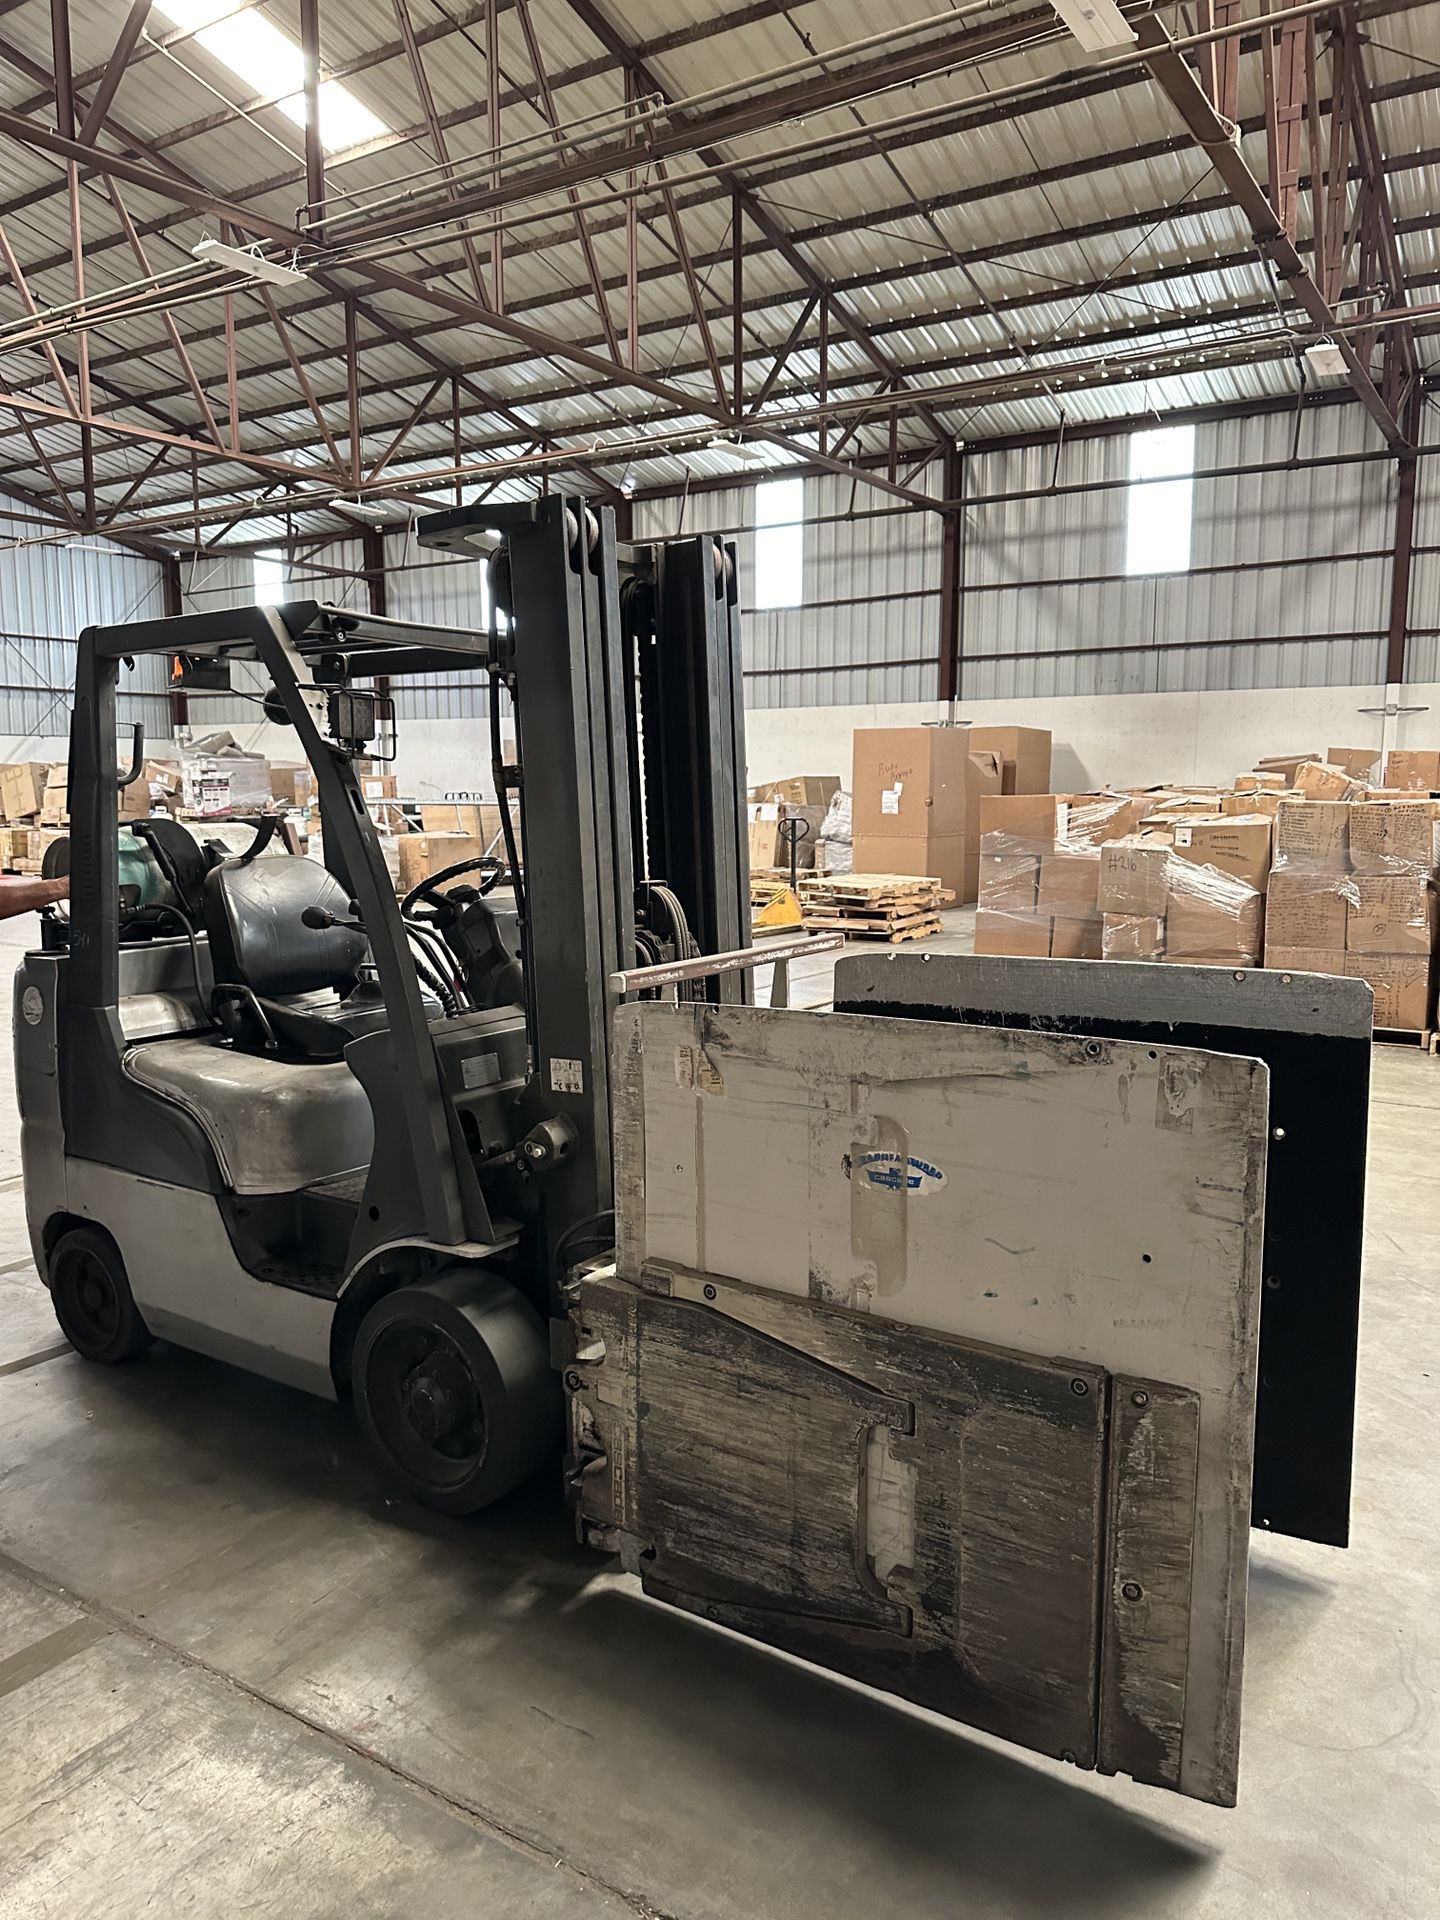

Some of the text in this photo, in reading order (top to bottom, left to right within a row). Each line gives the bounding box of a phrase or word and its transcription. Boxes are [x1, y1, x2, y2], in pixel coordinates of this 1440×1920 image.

[1107, 854, 1137, 872] #216
[859, 1153, 943, 1179] ANUFATURED
[874, 1174, 915, 1185] casce
